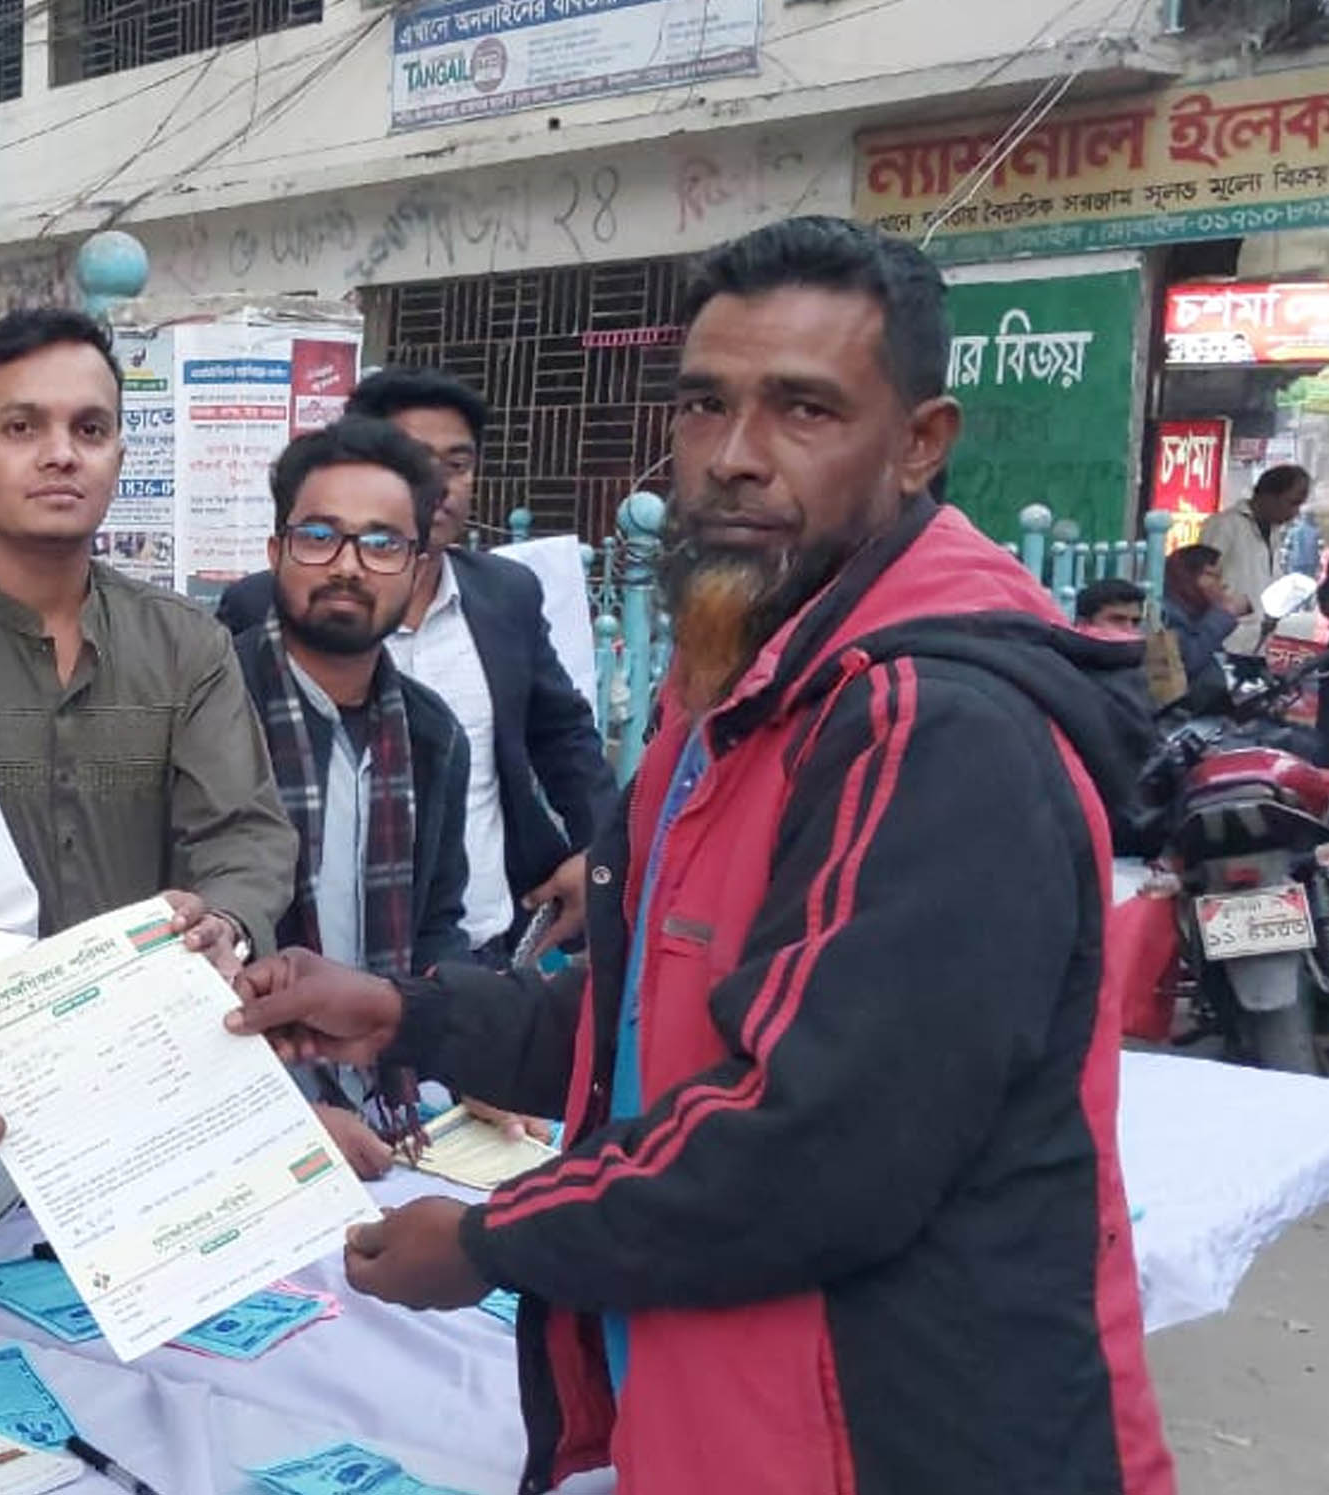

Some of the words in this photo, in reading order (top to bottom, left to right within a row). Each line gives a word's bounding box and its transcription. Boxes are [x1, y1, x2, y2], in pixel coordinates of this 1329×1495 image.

[403, 58, 473, 93] TANGAIL
[866, 107, 1156, 200] ন্যাশনাল
[994, 308, 1094, 388] বিজয়
[122, 407, 175, 432] ড়াতে
[1161, 429, 1219, 490] চশমা
[119, 480, 175, 496] 1826-0
